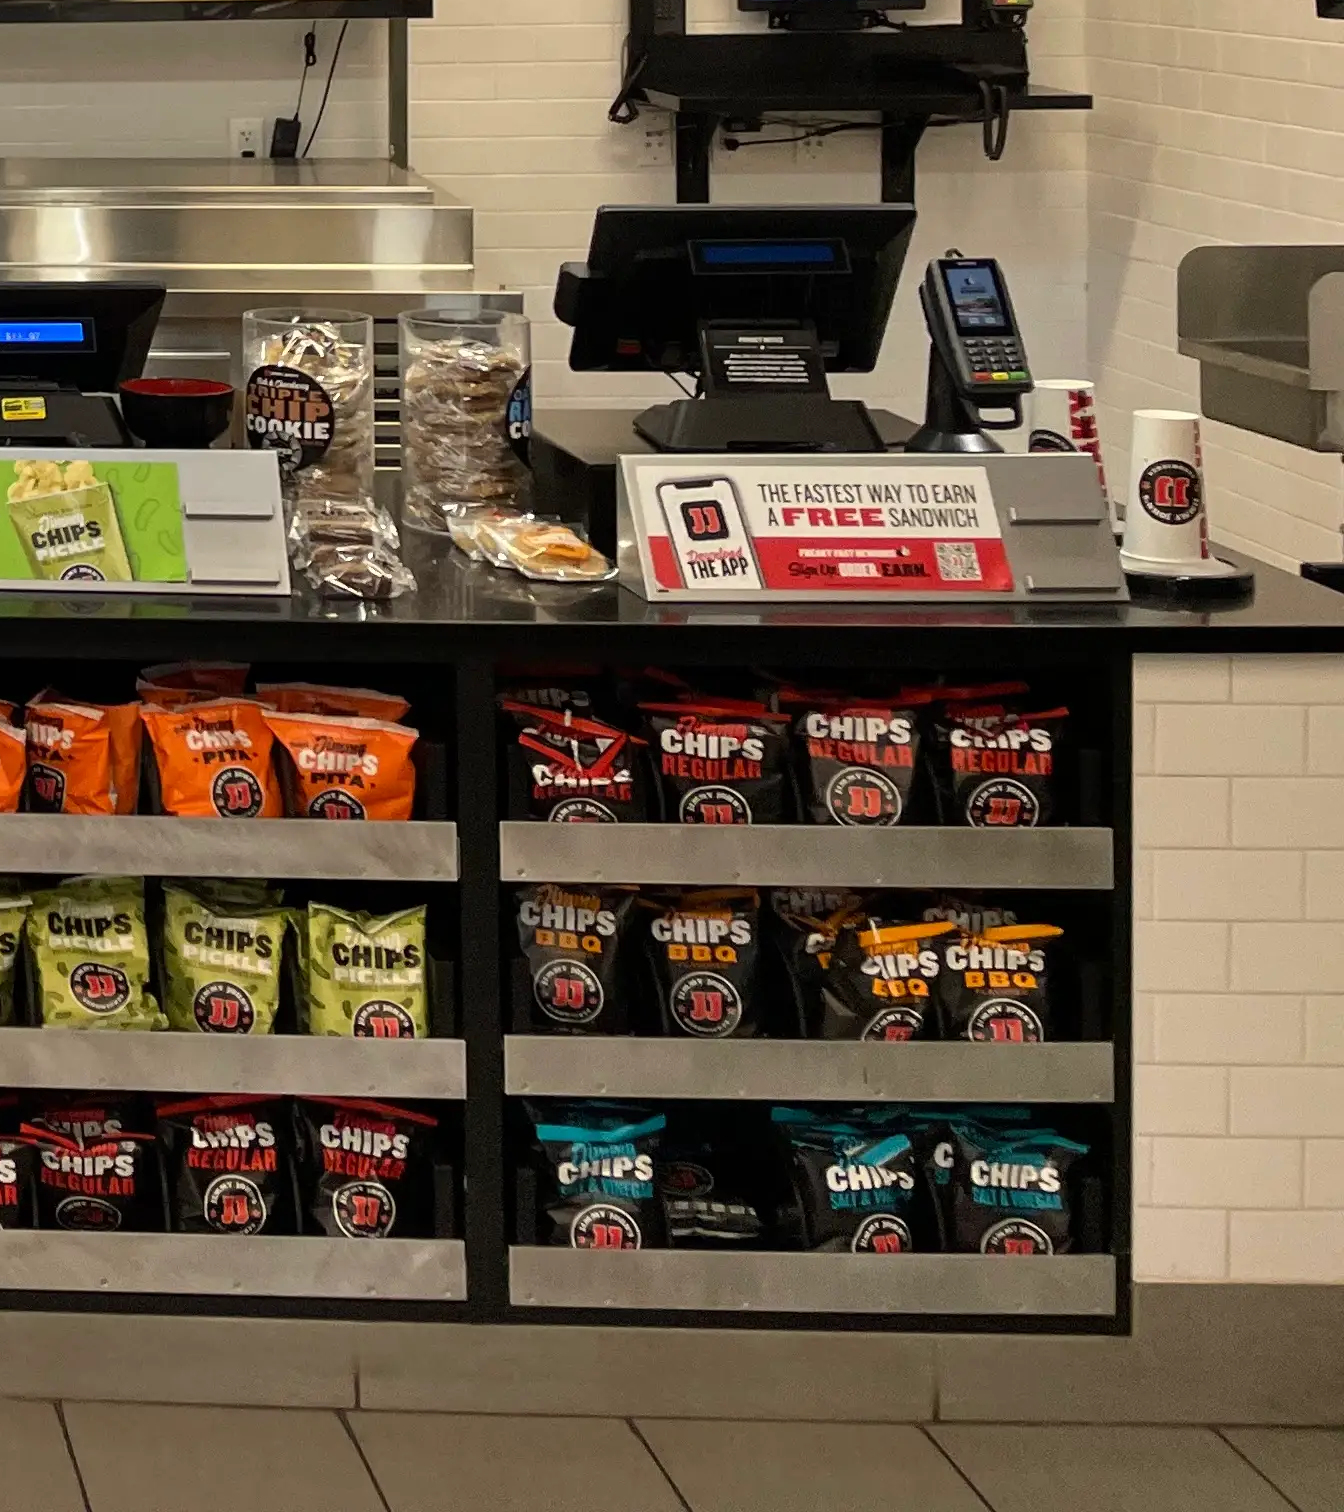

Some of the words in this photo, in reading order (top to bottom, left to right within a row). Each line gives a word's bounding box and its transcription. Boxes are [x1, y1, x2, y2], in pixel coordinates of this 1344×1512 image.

[250, 384, 323, 402] TRIPLE
[247, 395, 330, 421] CHIP
[246, 414, 330, 440] COOKIE
[757, 483, 791, 503] THE
[795, 484, 868, 503] FASTEST
[872, 484, 906, 503] WAY
[909, 484, 929, 503] TO
[933, 484, 977, 503] EARN
[689, 506, 720, 532] JJ
[768, 508, 779, 526] A
[783, 508, 885, 527] FREE
[889, 508, 979, 528] SANDWICH
[31, 521, 102, 549] CHIPS
[688, 560, 718, 579] THE
[721, 557, 748, 577] APP
[186, 729, 252, 751] CHIPS
[661, 728, 765, 761] CHIPS
[204, 750, 250, 764] PITA
[661, 753, 762, 781] REGULAR
[48, 911, 132, 937] CHIPS
[651, 918, 751, 946] CHIPS
[48, 934, 135, 952] PICKLE
[668, 943, 737, 965] BBQ
[946, 946, 1045, 972] CHIPS
[965, 970, 1038, 990] BBQ
[320, 1123, 410, 1156] CHIPS
[187, 1148, 276, 1172] REGULAR
[557, 1154, 654, 1185] CHIPS
